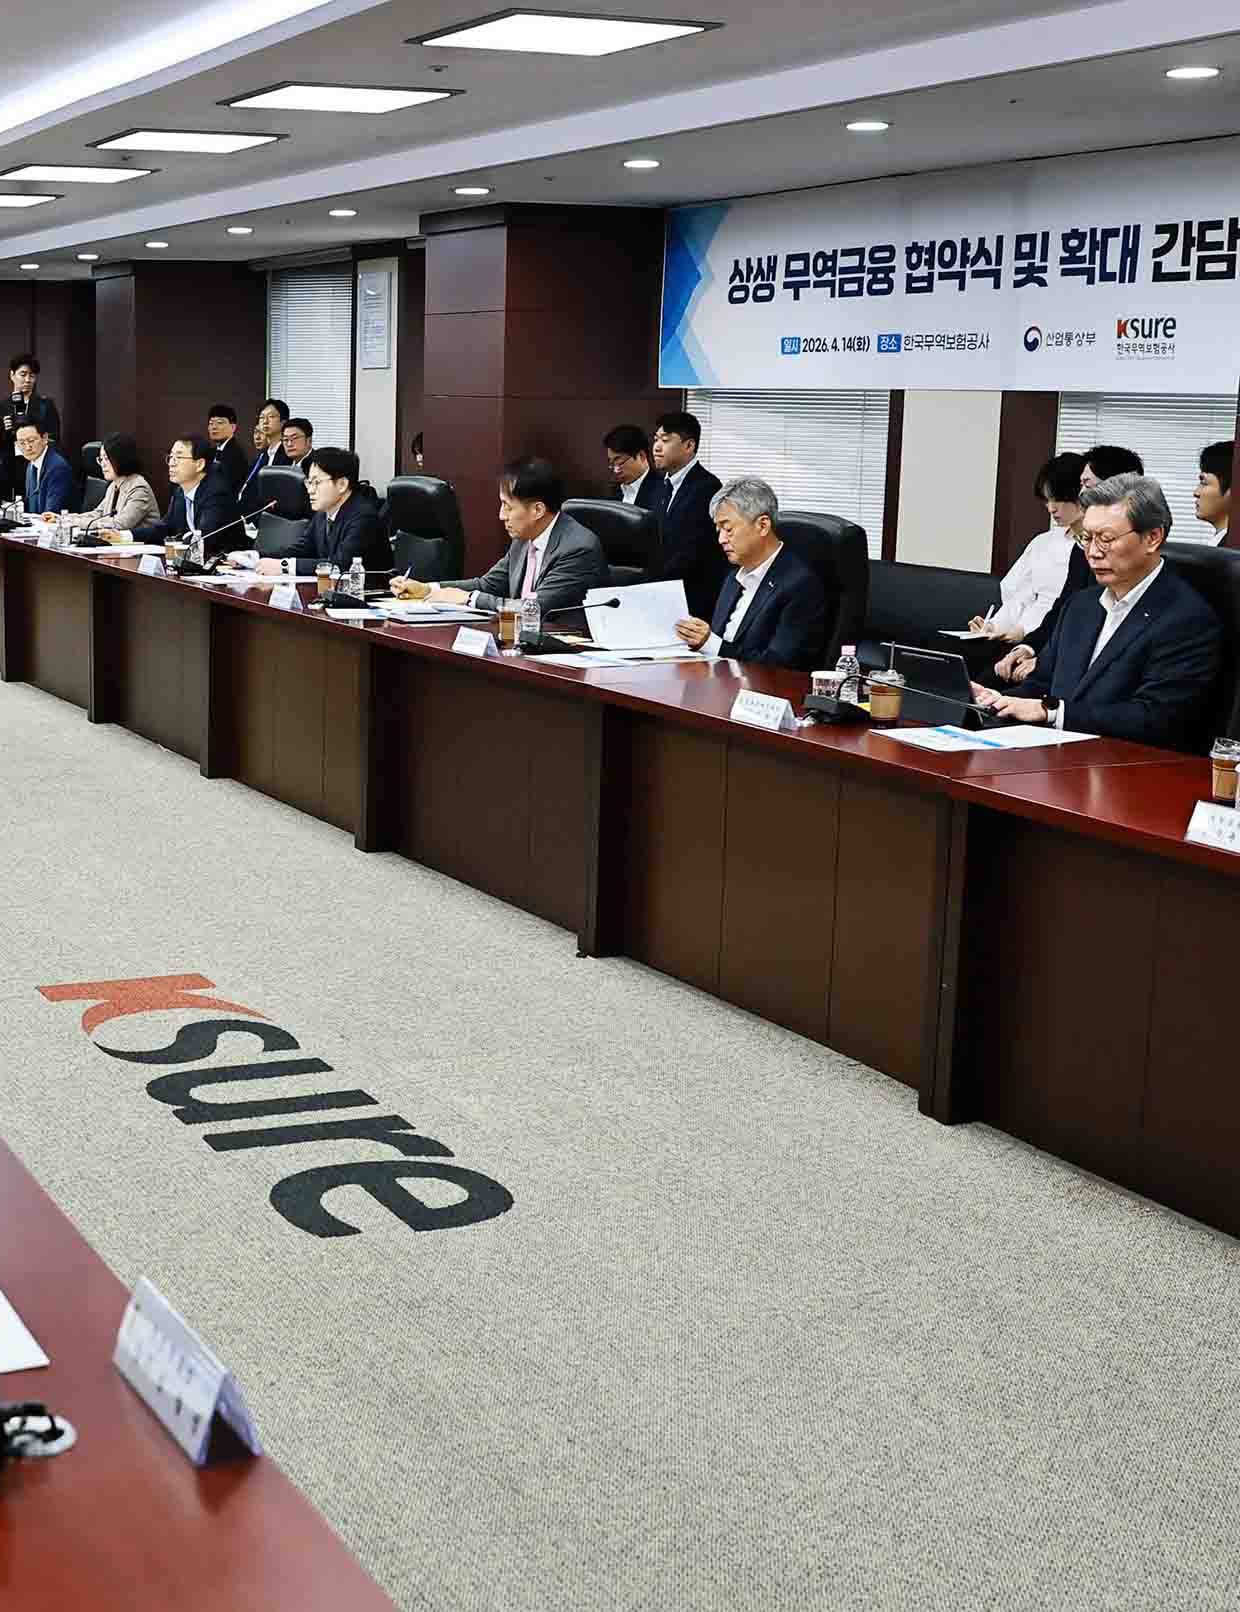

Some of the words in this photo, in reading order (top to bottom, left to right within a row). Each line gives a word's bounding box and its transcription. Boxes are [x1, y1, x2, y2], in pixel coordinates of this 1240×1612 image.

[728, 255, 778, 304] 상생
[783, 244, 896, 301] 무역금융
[905, 234, 1004, 294] 협약식
[1012, 231, 1050, 288] 및
[1059, 224, 1141, 285] 확대
[1151, 217, 1240, 282] 간담
[880, 335, 898, 351] 장소
[903, 332, 990, 352] 한국무역보험공사
[1045, 331, 1097, 347] 산업통상부
[1116, 343, 1176, 355] 한국무역보험공사
